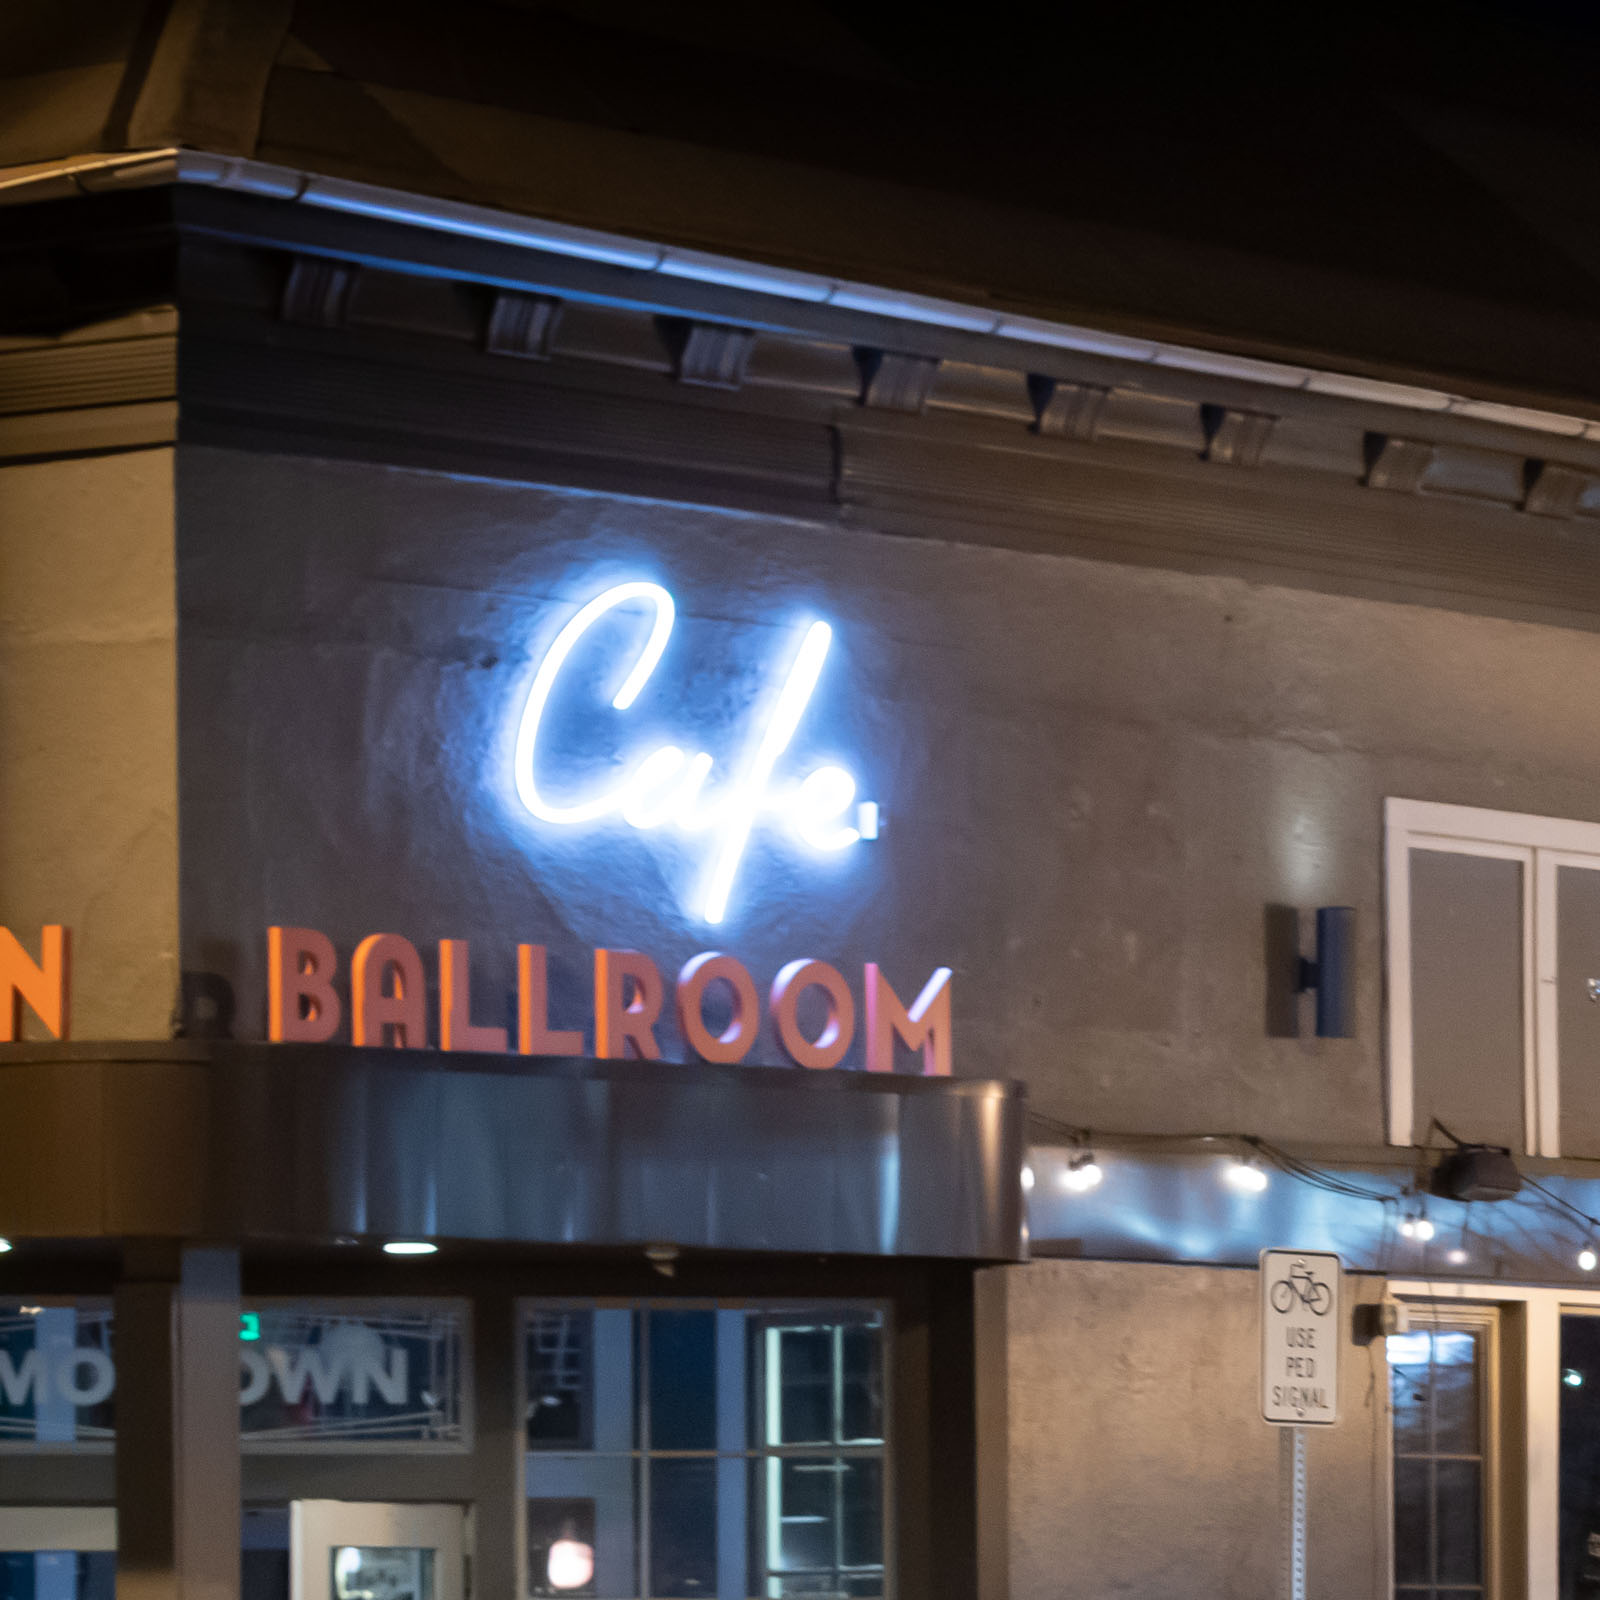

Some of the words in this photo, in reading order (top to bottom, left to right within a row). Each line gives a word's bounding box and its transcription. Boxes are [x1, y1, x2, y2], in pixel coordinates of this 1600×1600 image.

[513, 581, 861, 926] Cafe
[267, 924, 953, 1076] BALLROOM
[1285, 1326, 1317, 1348] USE
[1285, 1356, 1316, 1378] PED
[1273, 1385, 1329, 1408] SIGNAL
